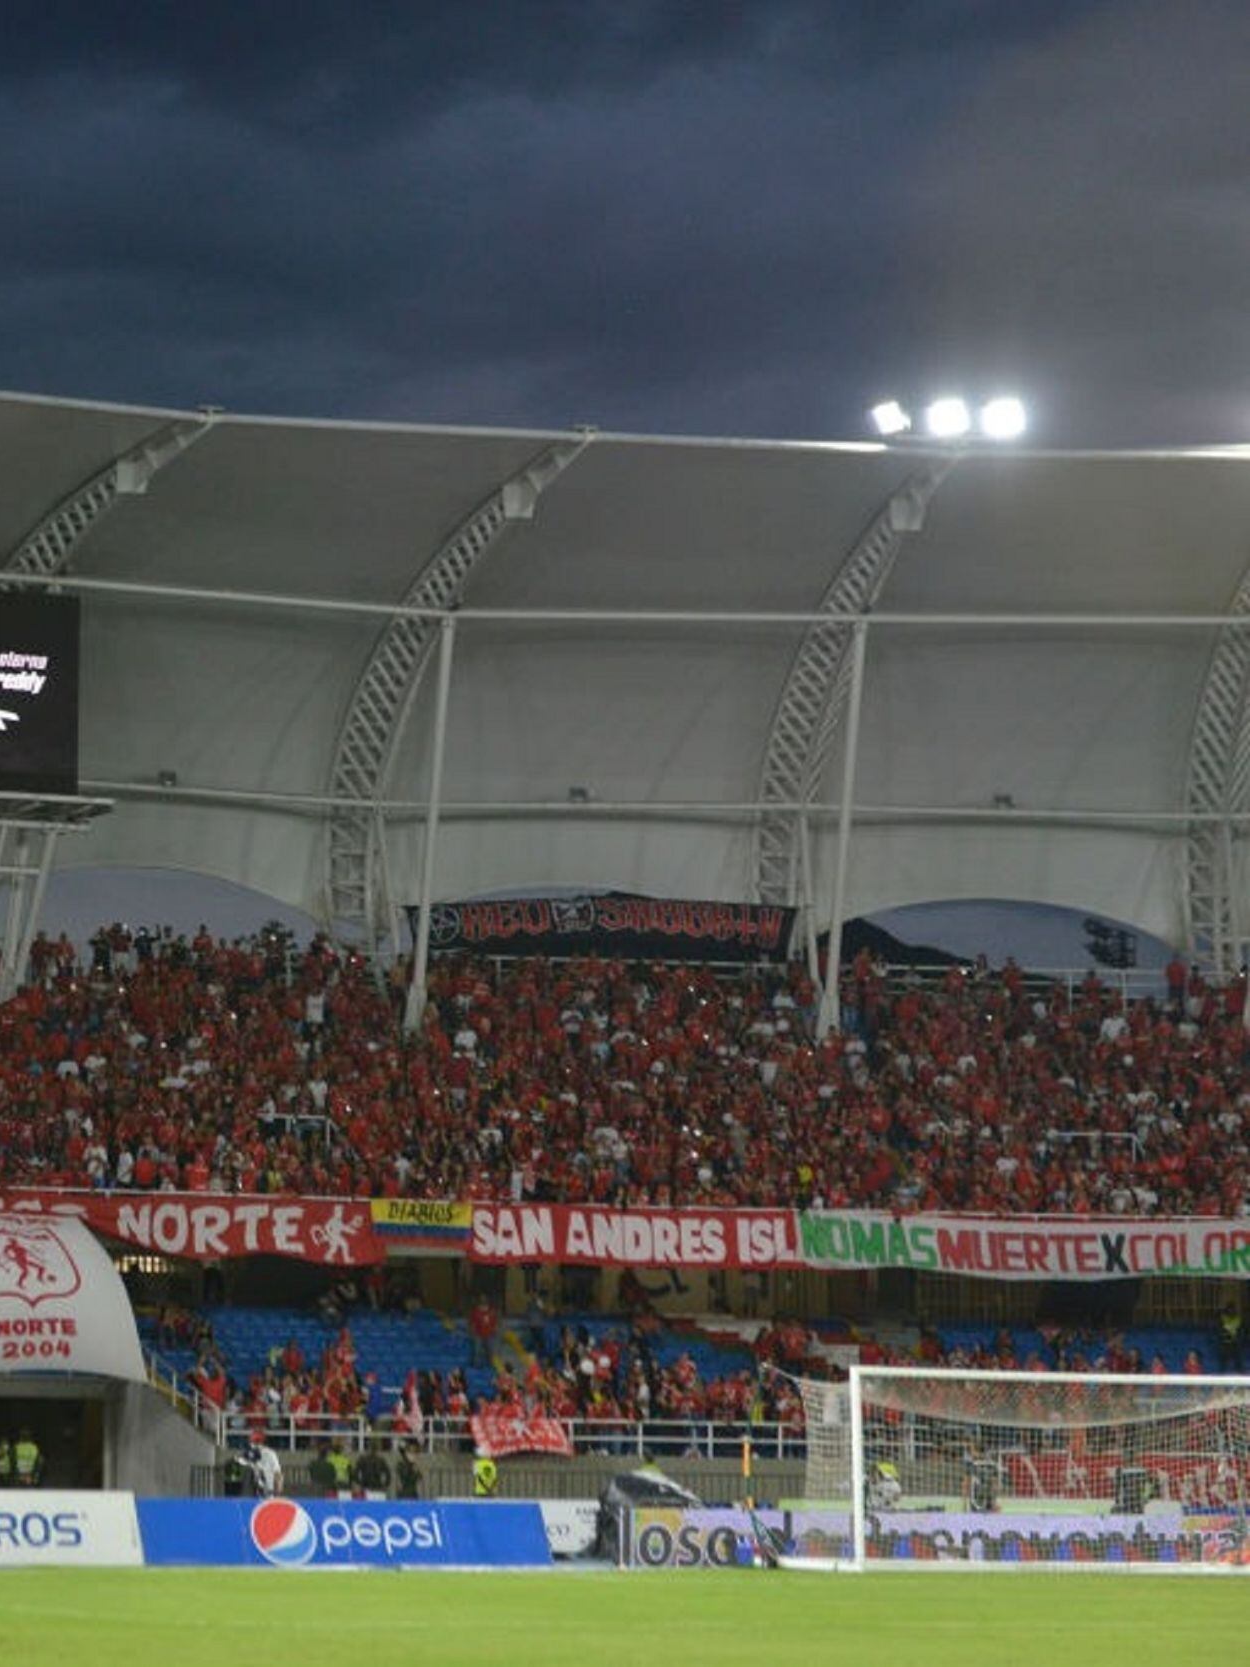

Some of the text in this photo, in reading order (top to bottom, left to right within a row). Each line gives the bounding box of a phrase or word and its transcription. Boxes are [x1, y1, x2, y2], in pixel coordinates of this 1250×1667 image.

[117, 1202, 306, 1254] NORTE
[473, 1207, 554, 1256] SAN
[565, 1211, 726, 1263] ANDRES
[1, 1341, 71, 1360] 2004
[322, 1510, 443, 1555] pepsi
